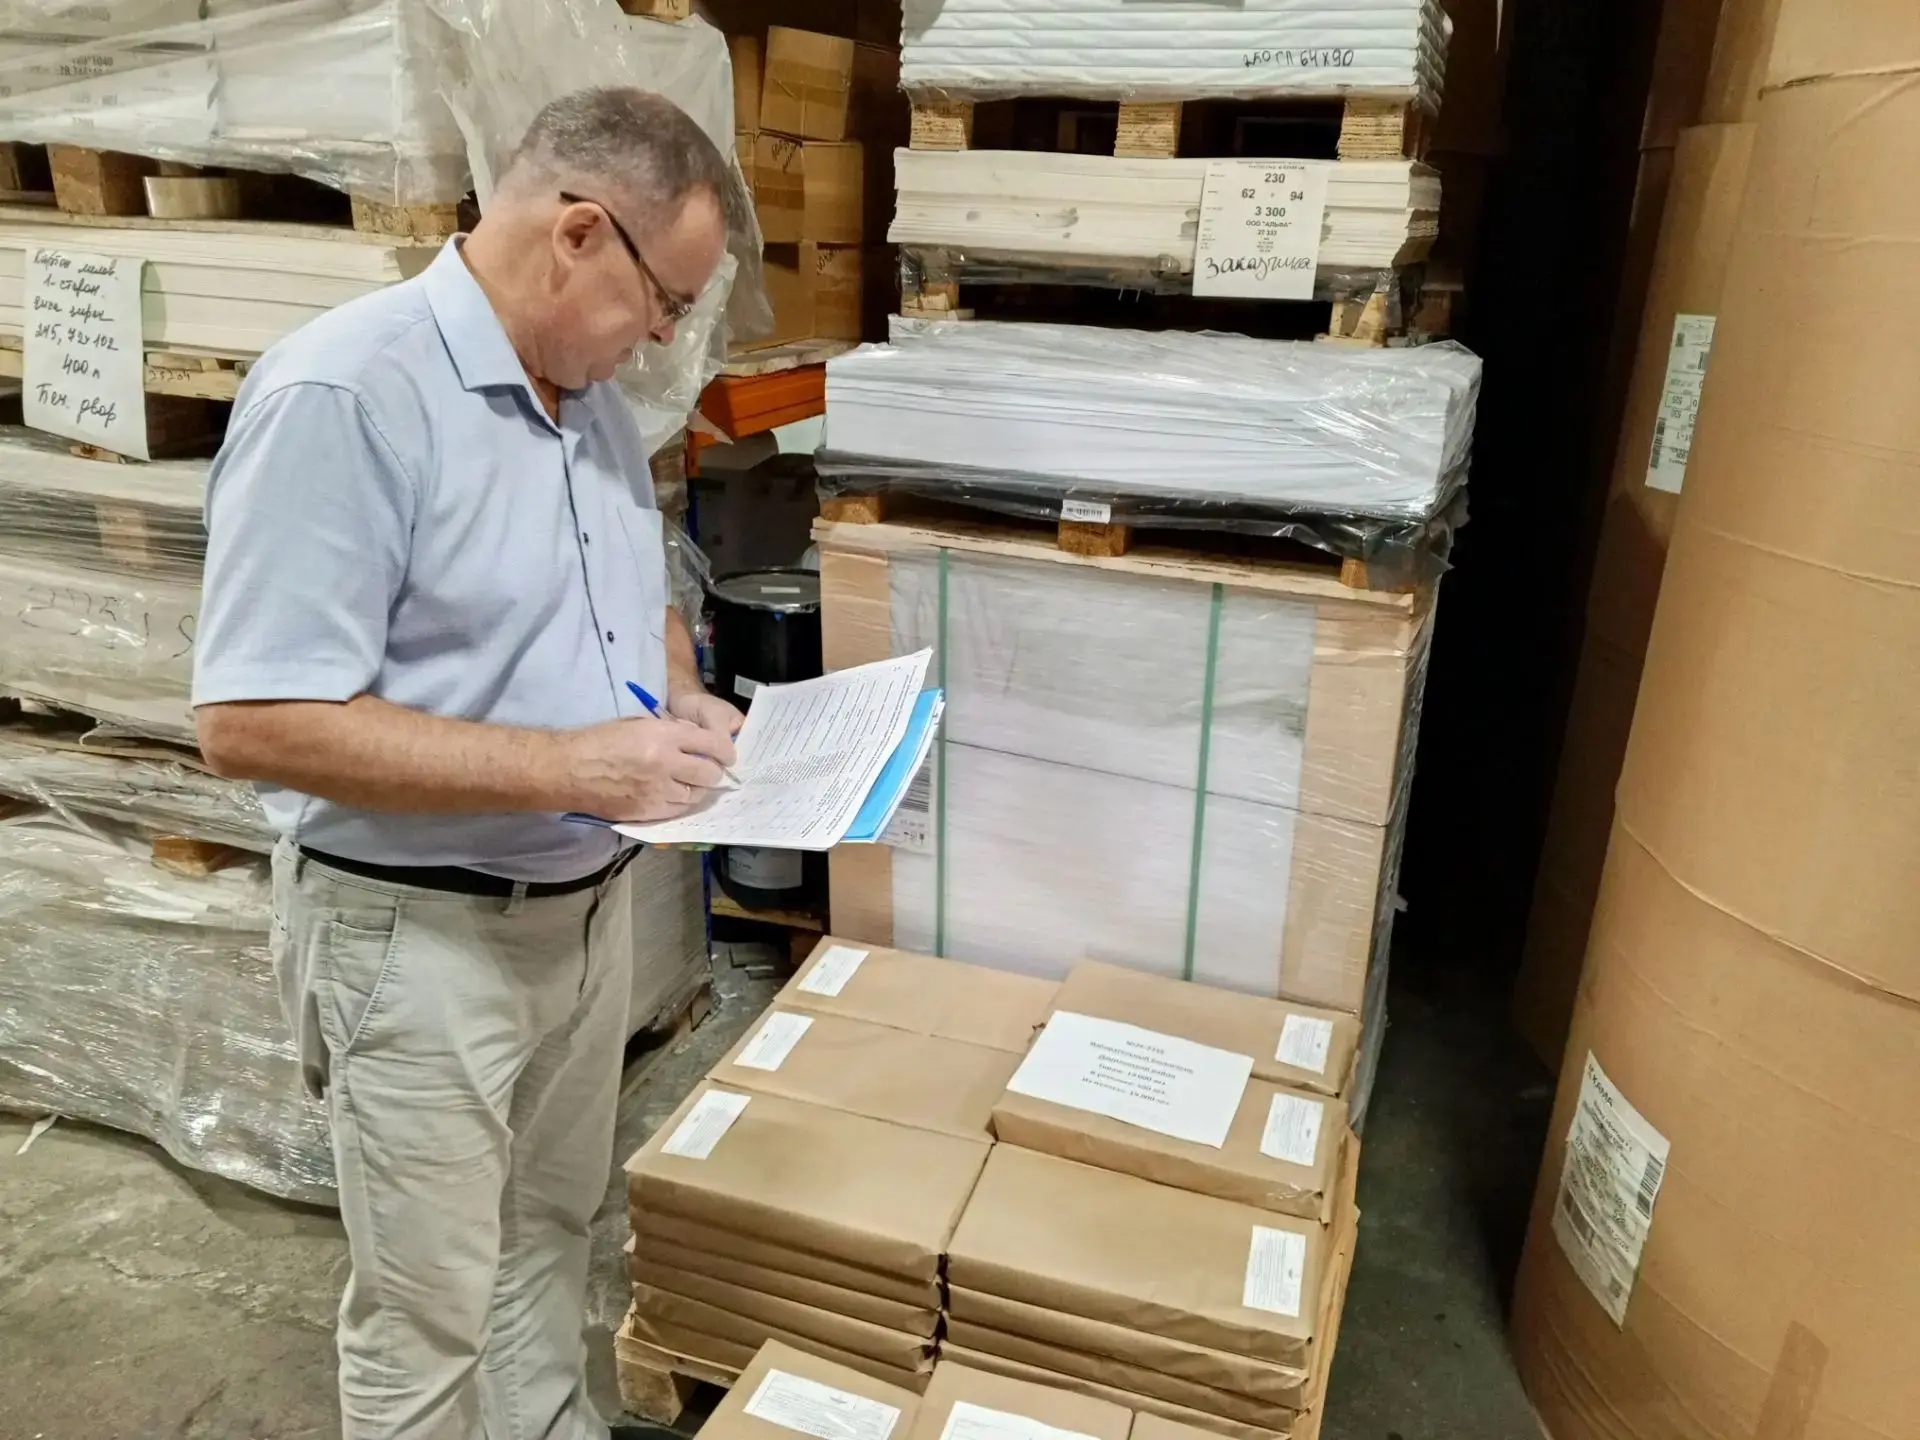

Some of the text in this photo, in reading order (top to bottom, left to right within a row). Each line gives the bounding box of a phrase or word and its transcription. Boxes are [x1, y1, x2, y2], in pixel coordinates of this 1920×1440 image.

[1264, 172, 1286, 184] 230
[1241, 188, 1256, 199] 62
[1290, 191, 1304, 201] 94
[1255, 206, 1286, 217] 3 300
[62, 353, 89, 375] 400
